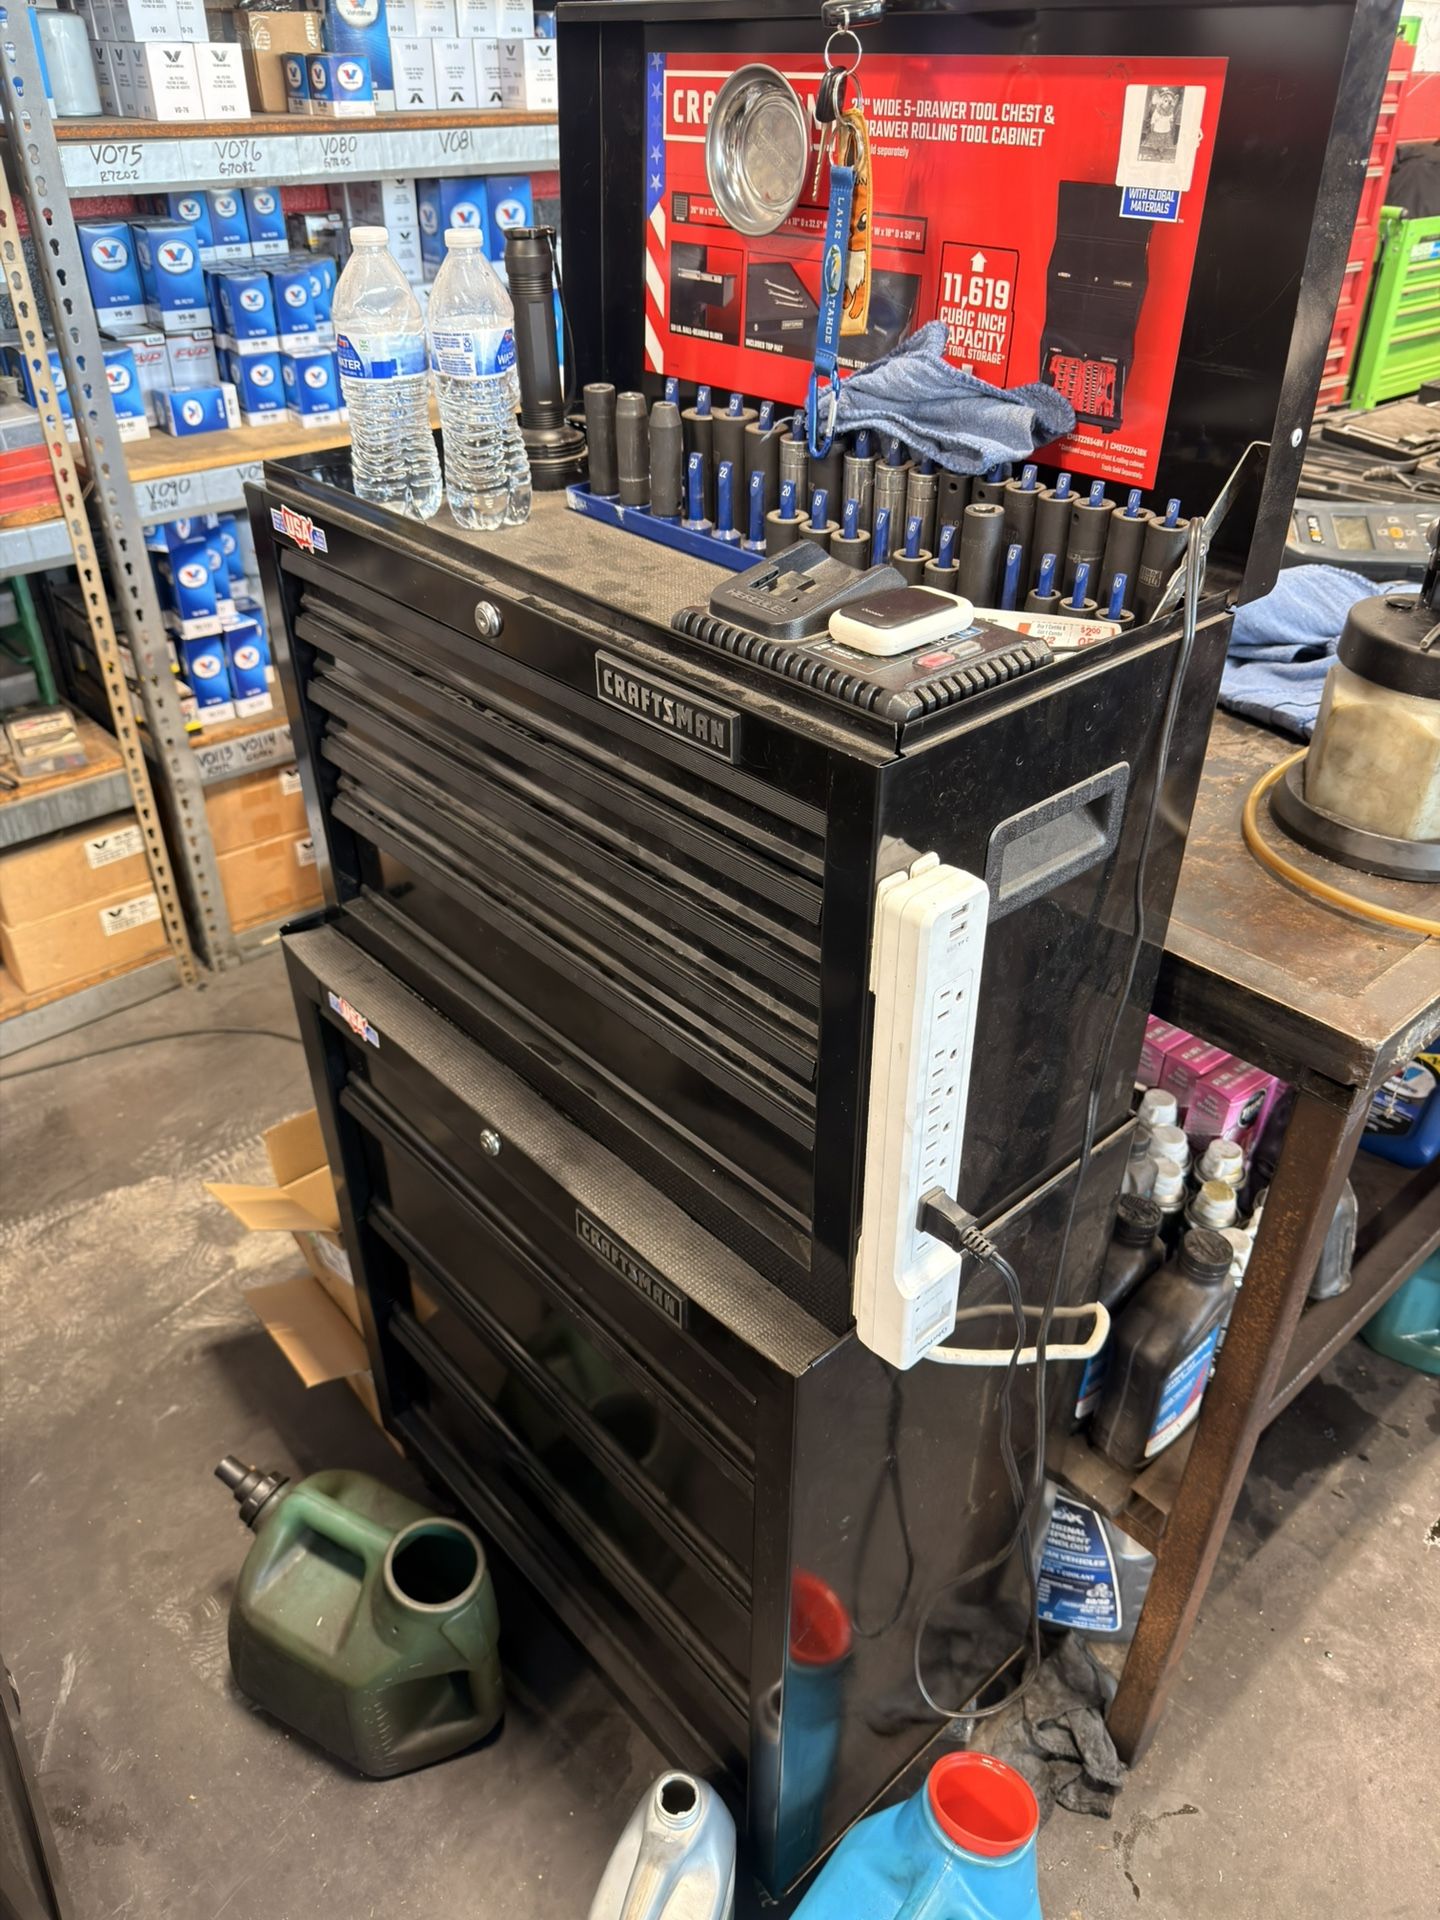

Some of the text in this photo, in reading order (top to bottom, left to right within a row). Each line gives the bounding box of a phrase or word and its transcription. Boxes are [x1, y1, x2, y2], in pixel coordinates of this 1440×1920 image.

[872, 98, 902, 117] WIDE
[903, 99, 967, 120] 5-DRAWER
[969, 102, 999, 121] TOOL
[1001, 103, 1043, 124] CHEST
[1043, 104, 1056, 125] &
[911, 122, 958, 142] ROLLING
[960, 124, 989, 144] TOOL
[991, 126, 1046, 147] CABINET
[877, 147, 910, 159] separately
[1128, 187, 1176, 203] WITH GLOBAL
[1130, 199, 1170, 214] MATERIALS
[834, 196, 846, 239] LAKE
[943, 271, 1011, 310] 11,619
[824, 299, 837, 345] TAHOE
[940, 305, 1007, 333] CUBIC INCH
[947, 325, 1006, 353] APACITY
[175, 346, 209, 358] FVP
[948, 343, 967, 358] TOOL
[729, 399, 739, 411] 23
[761, 406, 770, 418] 22
[689, 458, 698, 469] 23
[719, 467, 728, 479] 22
[1024, 467, 1032, 479] 14
[1059, 477, 1067, 488] 13
[781, 485, 791, 497] 20
[1092, 485, 1100, 496] 12
[814, 495, 822, 506] 19
[1130, 493, 1137, 503] 11
[845, 503, 853, 515] 18
[1168, 501, 1177, 512] 10
[877, 512, 885, 524] 17
[284, 513, 310, 542] USA
[909, 521, 917, 532] 16
[942, 530, 950, 542] 15
[1042, 558, 1051, 569] 12
[1078, 566, 1086, 577] 11
[1113, 577, 1122, 588] 10
[603, 669, 725, 748] CRAFTSMAN
[581, 1220, 675, 1317] CRAFTSMAN
[1060, 1553, 1107, 1567] VEHICLES
